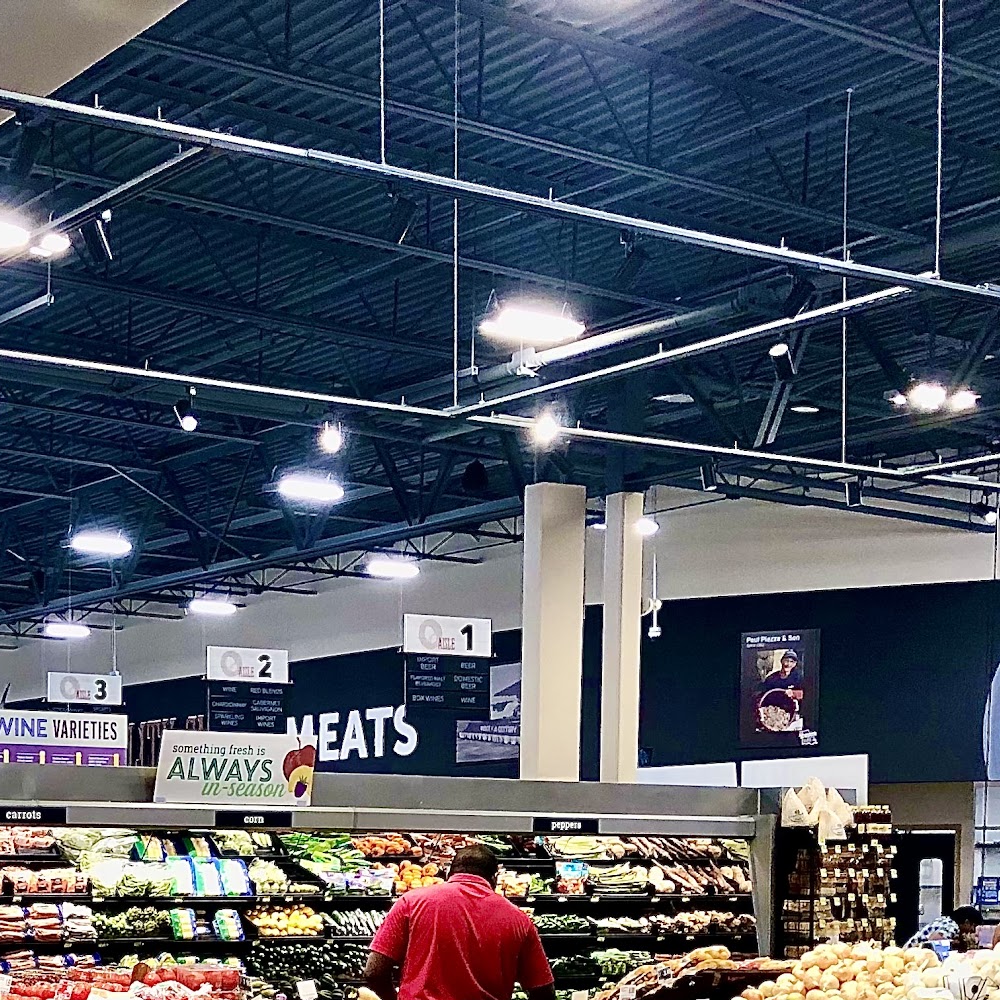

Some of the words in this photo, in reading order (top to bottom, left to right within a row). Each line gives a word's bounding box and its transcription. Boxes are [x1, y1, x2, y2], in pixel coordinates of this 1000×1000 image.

[460, 624, 473, 651] 1
[257, 654, 272, 678] 2
[93, 679, 107, 700] 3
[52, 719, 118, 741] VARIETIES
[172, 743, 226, 757] something
[228, 744, 254, 756] fresh
[257, 745, 266, 756] is
[166, 757, 274, 783] ALWAYS
[201, 781, 287, 798] in-season
[5, 810, 42, 820] carrots
[243, 816, 265, 824] corn
[551, 821, 582, 831] peppers
